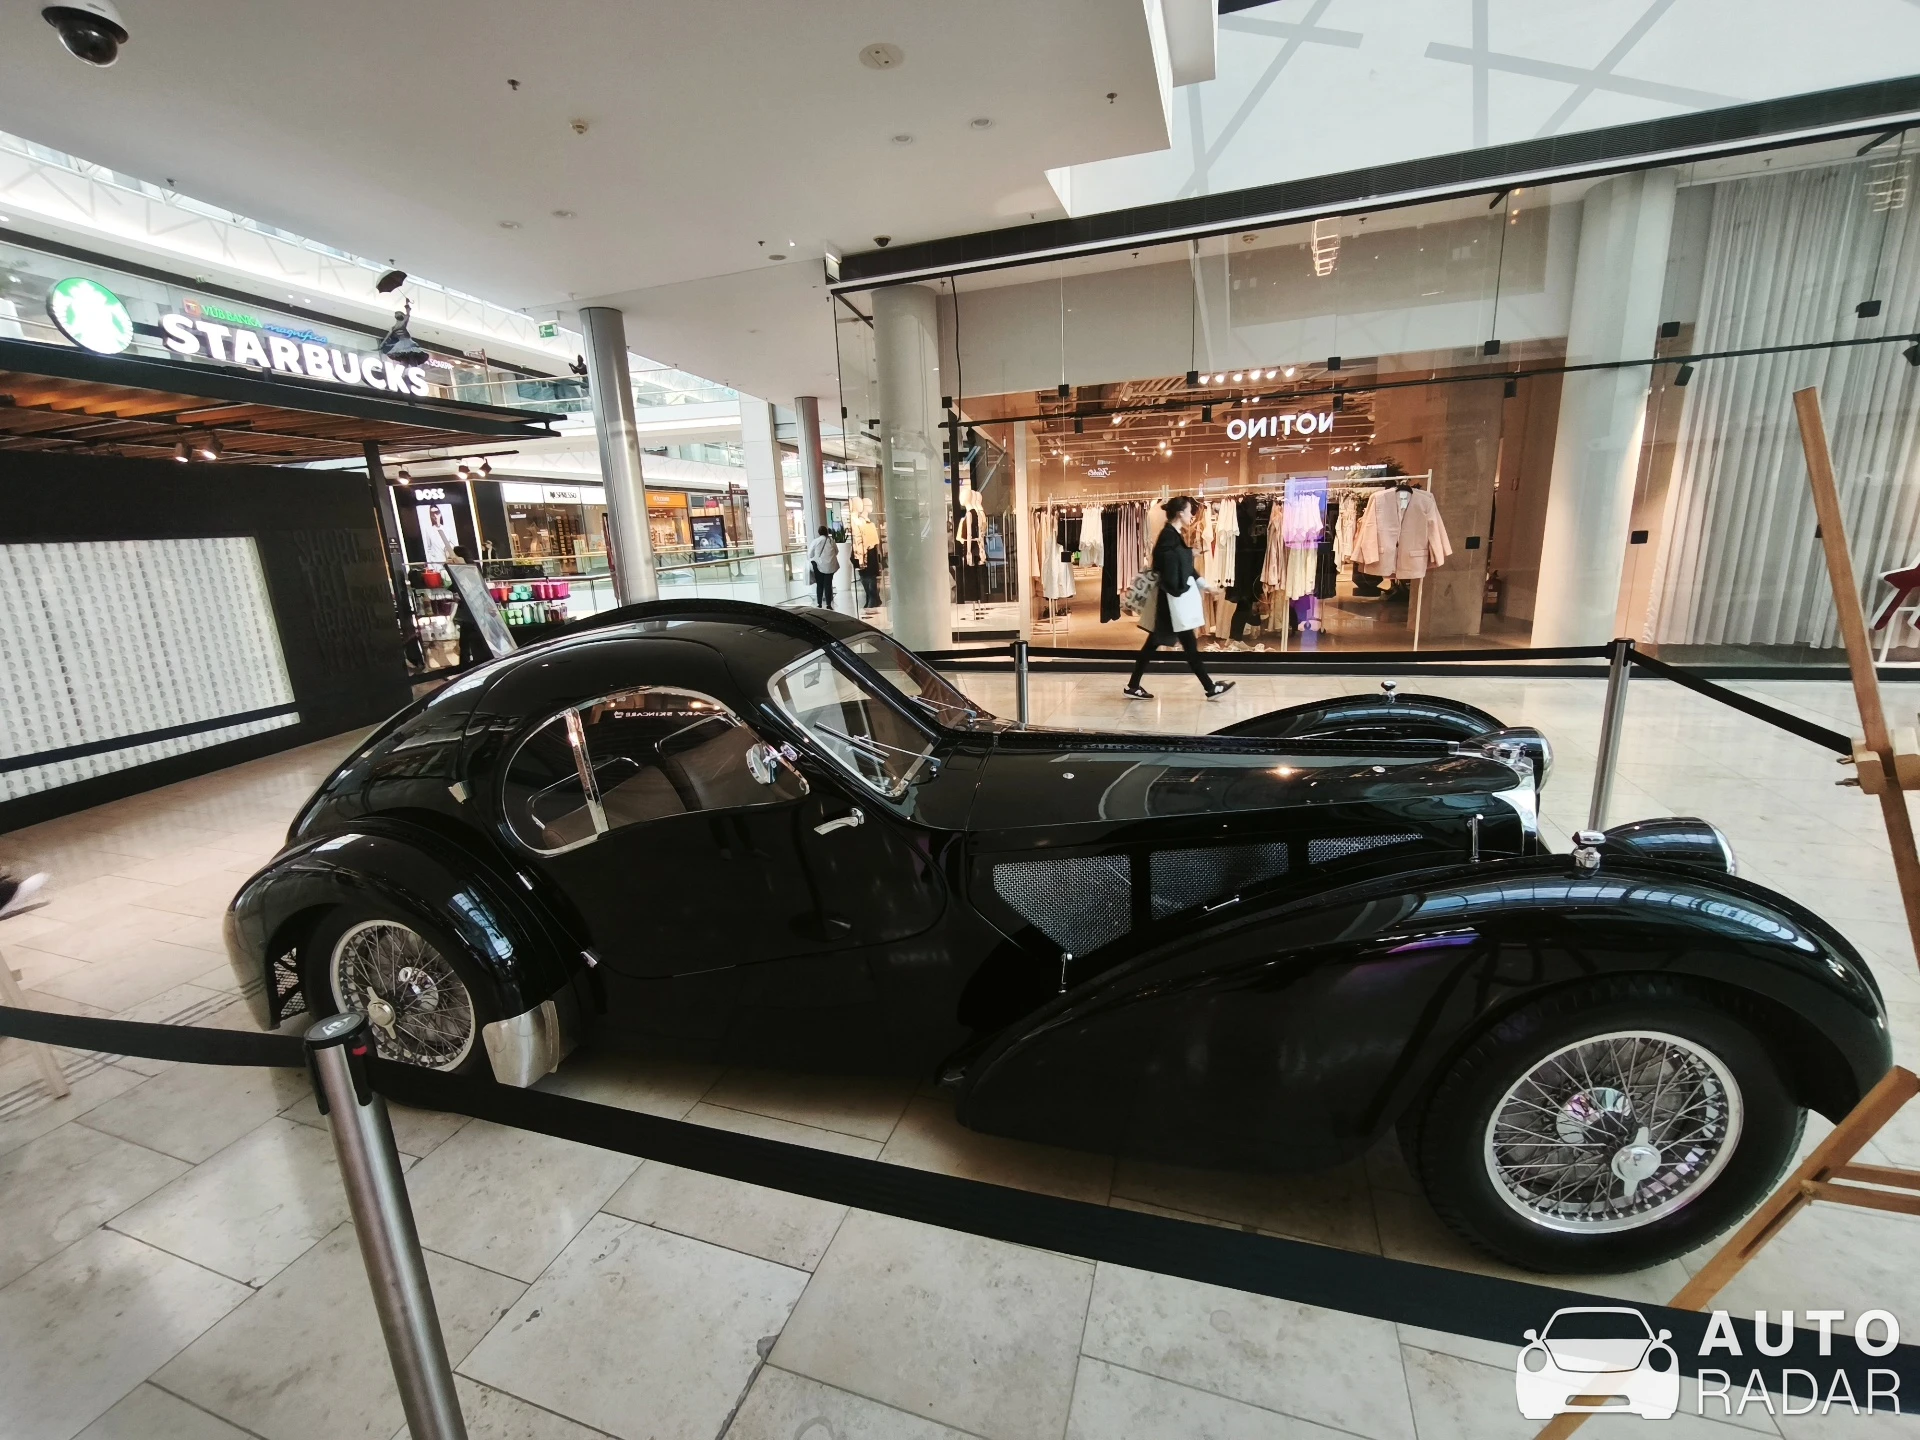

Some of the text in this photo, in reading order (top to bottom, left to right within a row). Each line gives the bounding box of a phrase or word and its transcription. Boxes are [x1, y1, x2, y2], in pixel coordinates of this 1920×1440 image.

[227, 310, 263, 329] BANKA
[160, 313, 430, 397] STARBUCKS
[415, 488, 446, 501] BOSS
